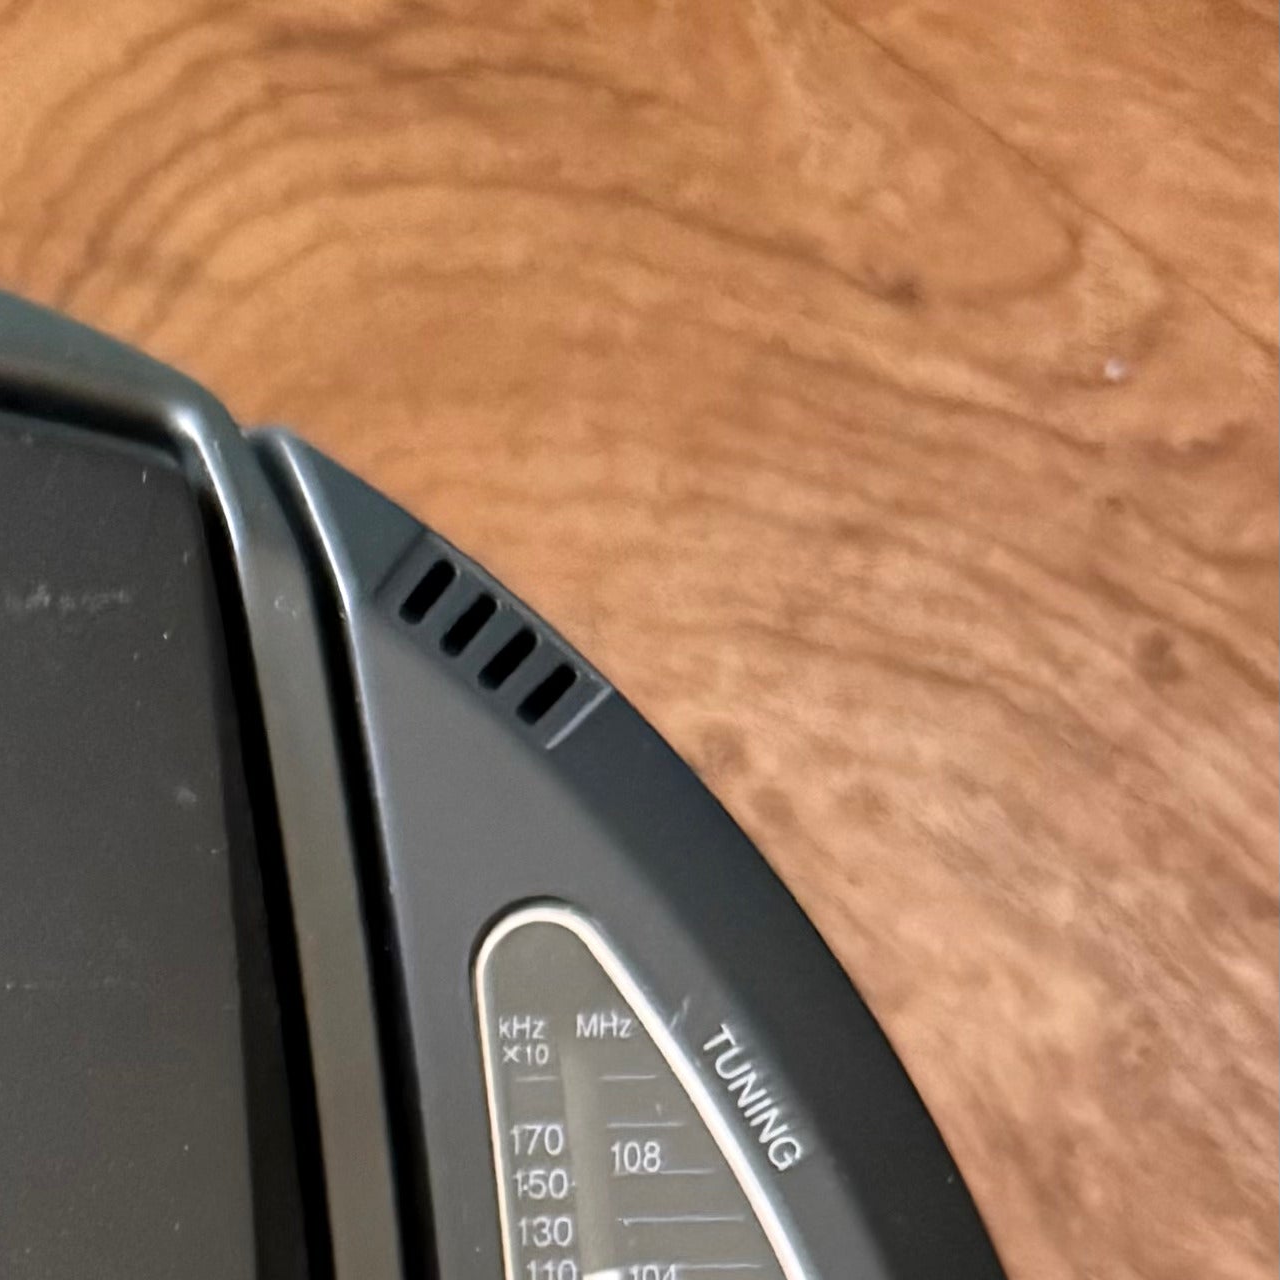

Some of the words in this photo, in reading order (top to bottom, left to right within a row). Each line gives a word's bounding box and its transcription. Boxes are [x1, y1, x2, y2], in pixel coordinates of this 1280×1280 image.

[498, 1017, 546, 1040] kHz
[576, 1014, 634, 1039] MHz
[702, 1024, 805, 1172] TUNING
[511, 1124, 564, 1155] 170
[610, 1142, 661, 1173] 108
[514, 1169, 568, 1200] 150
[519, 1217, 573, 1247] 130
